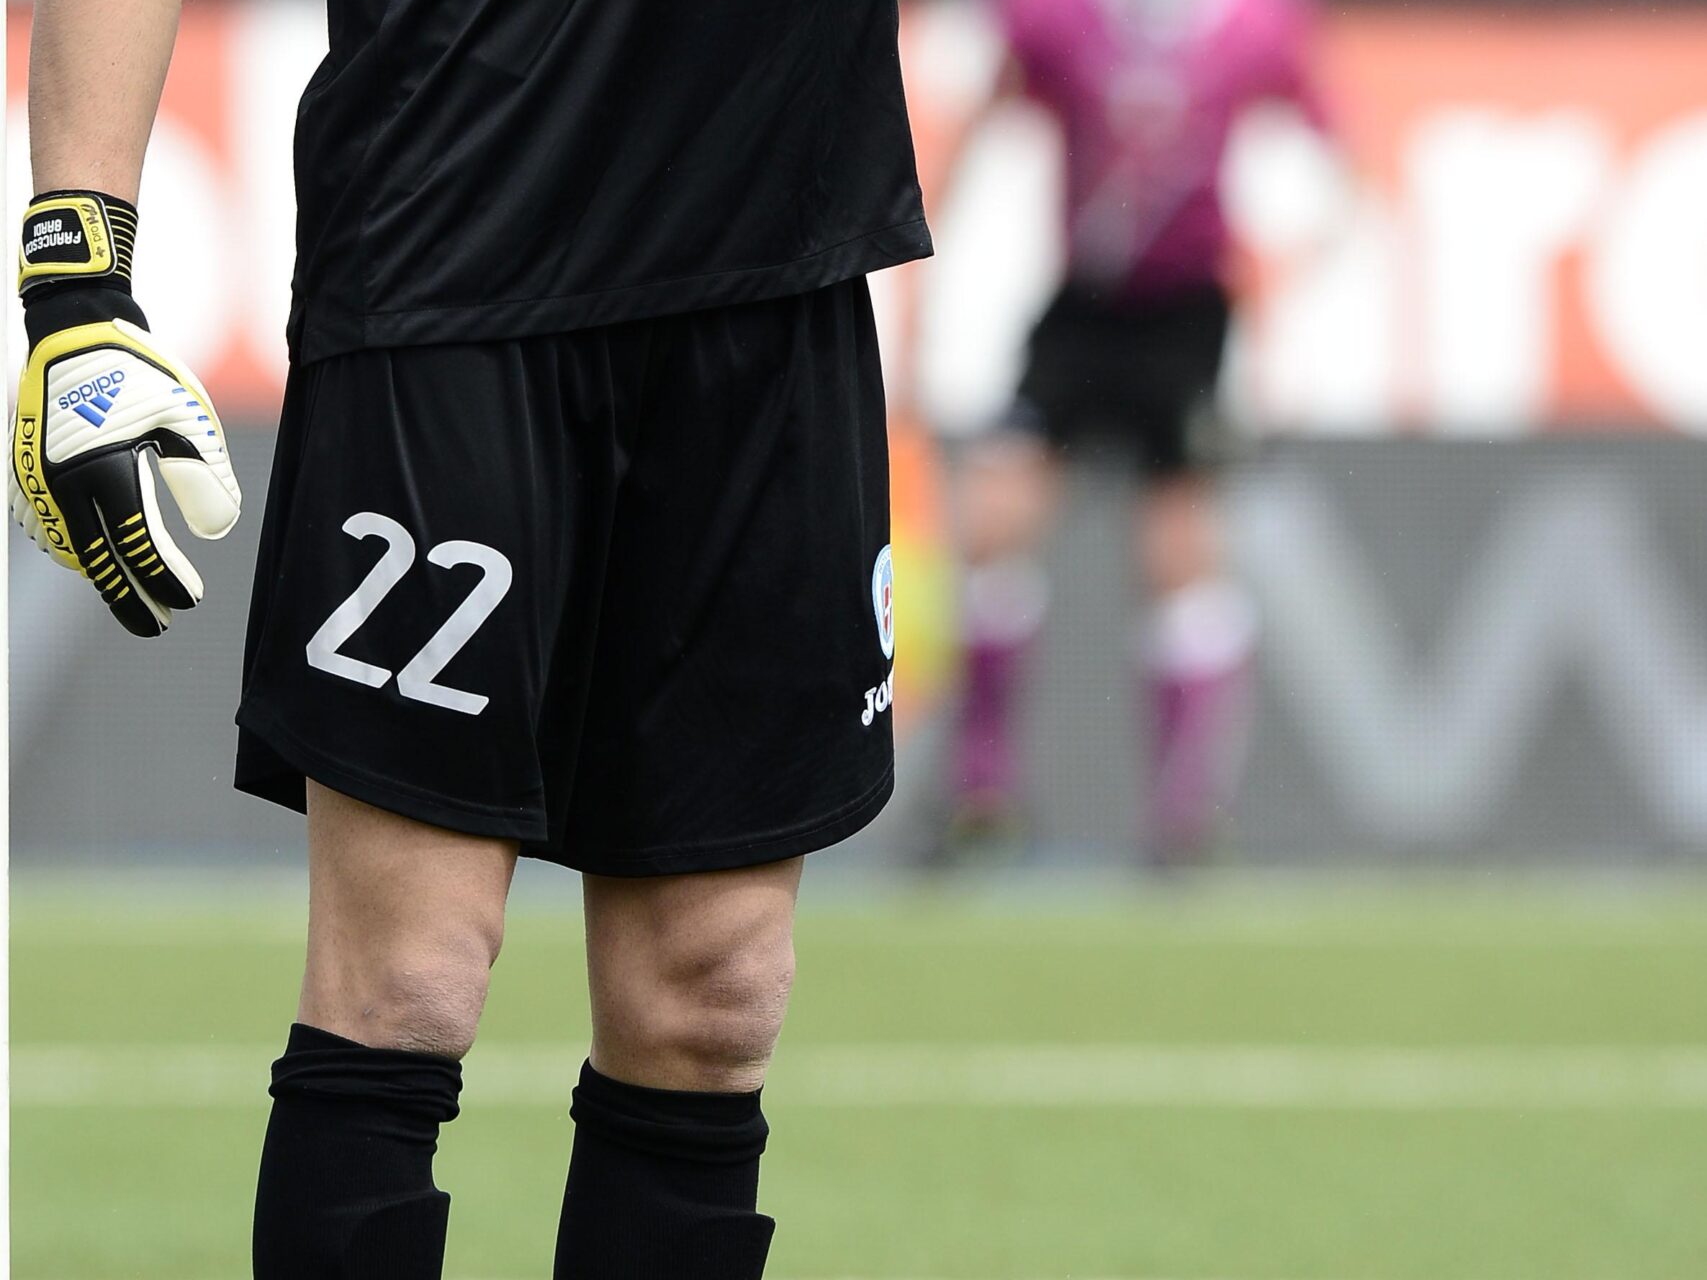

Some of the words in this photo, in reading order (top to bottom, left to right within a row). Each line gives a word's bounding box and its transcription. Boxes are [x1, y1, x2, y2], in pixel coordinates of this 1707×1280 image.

[58, 370, 126, 410] adidas
[21, 417, 74, 556] predator
[305, 511, 514, 716] 22
